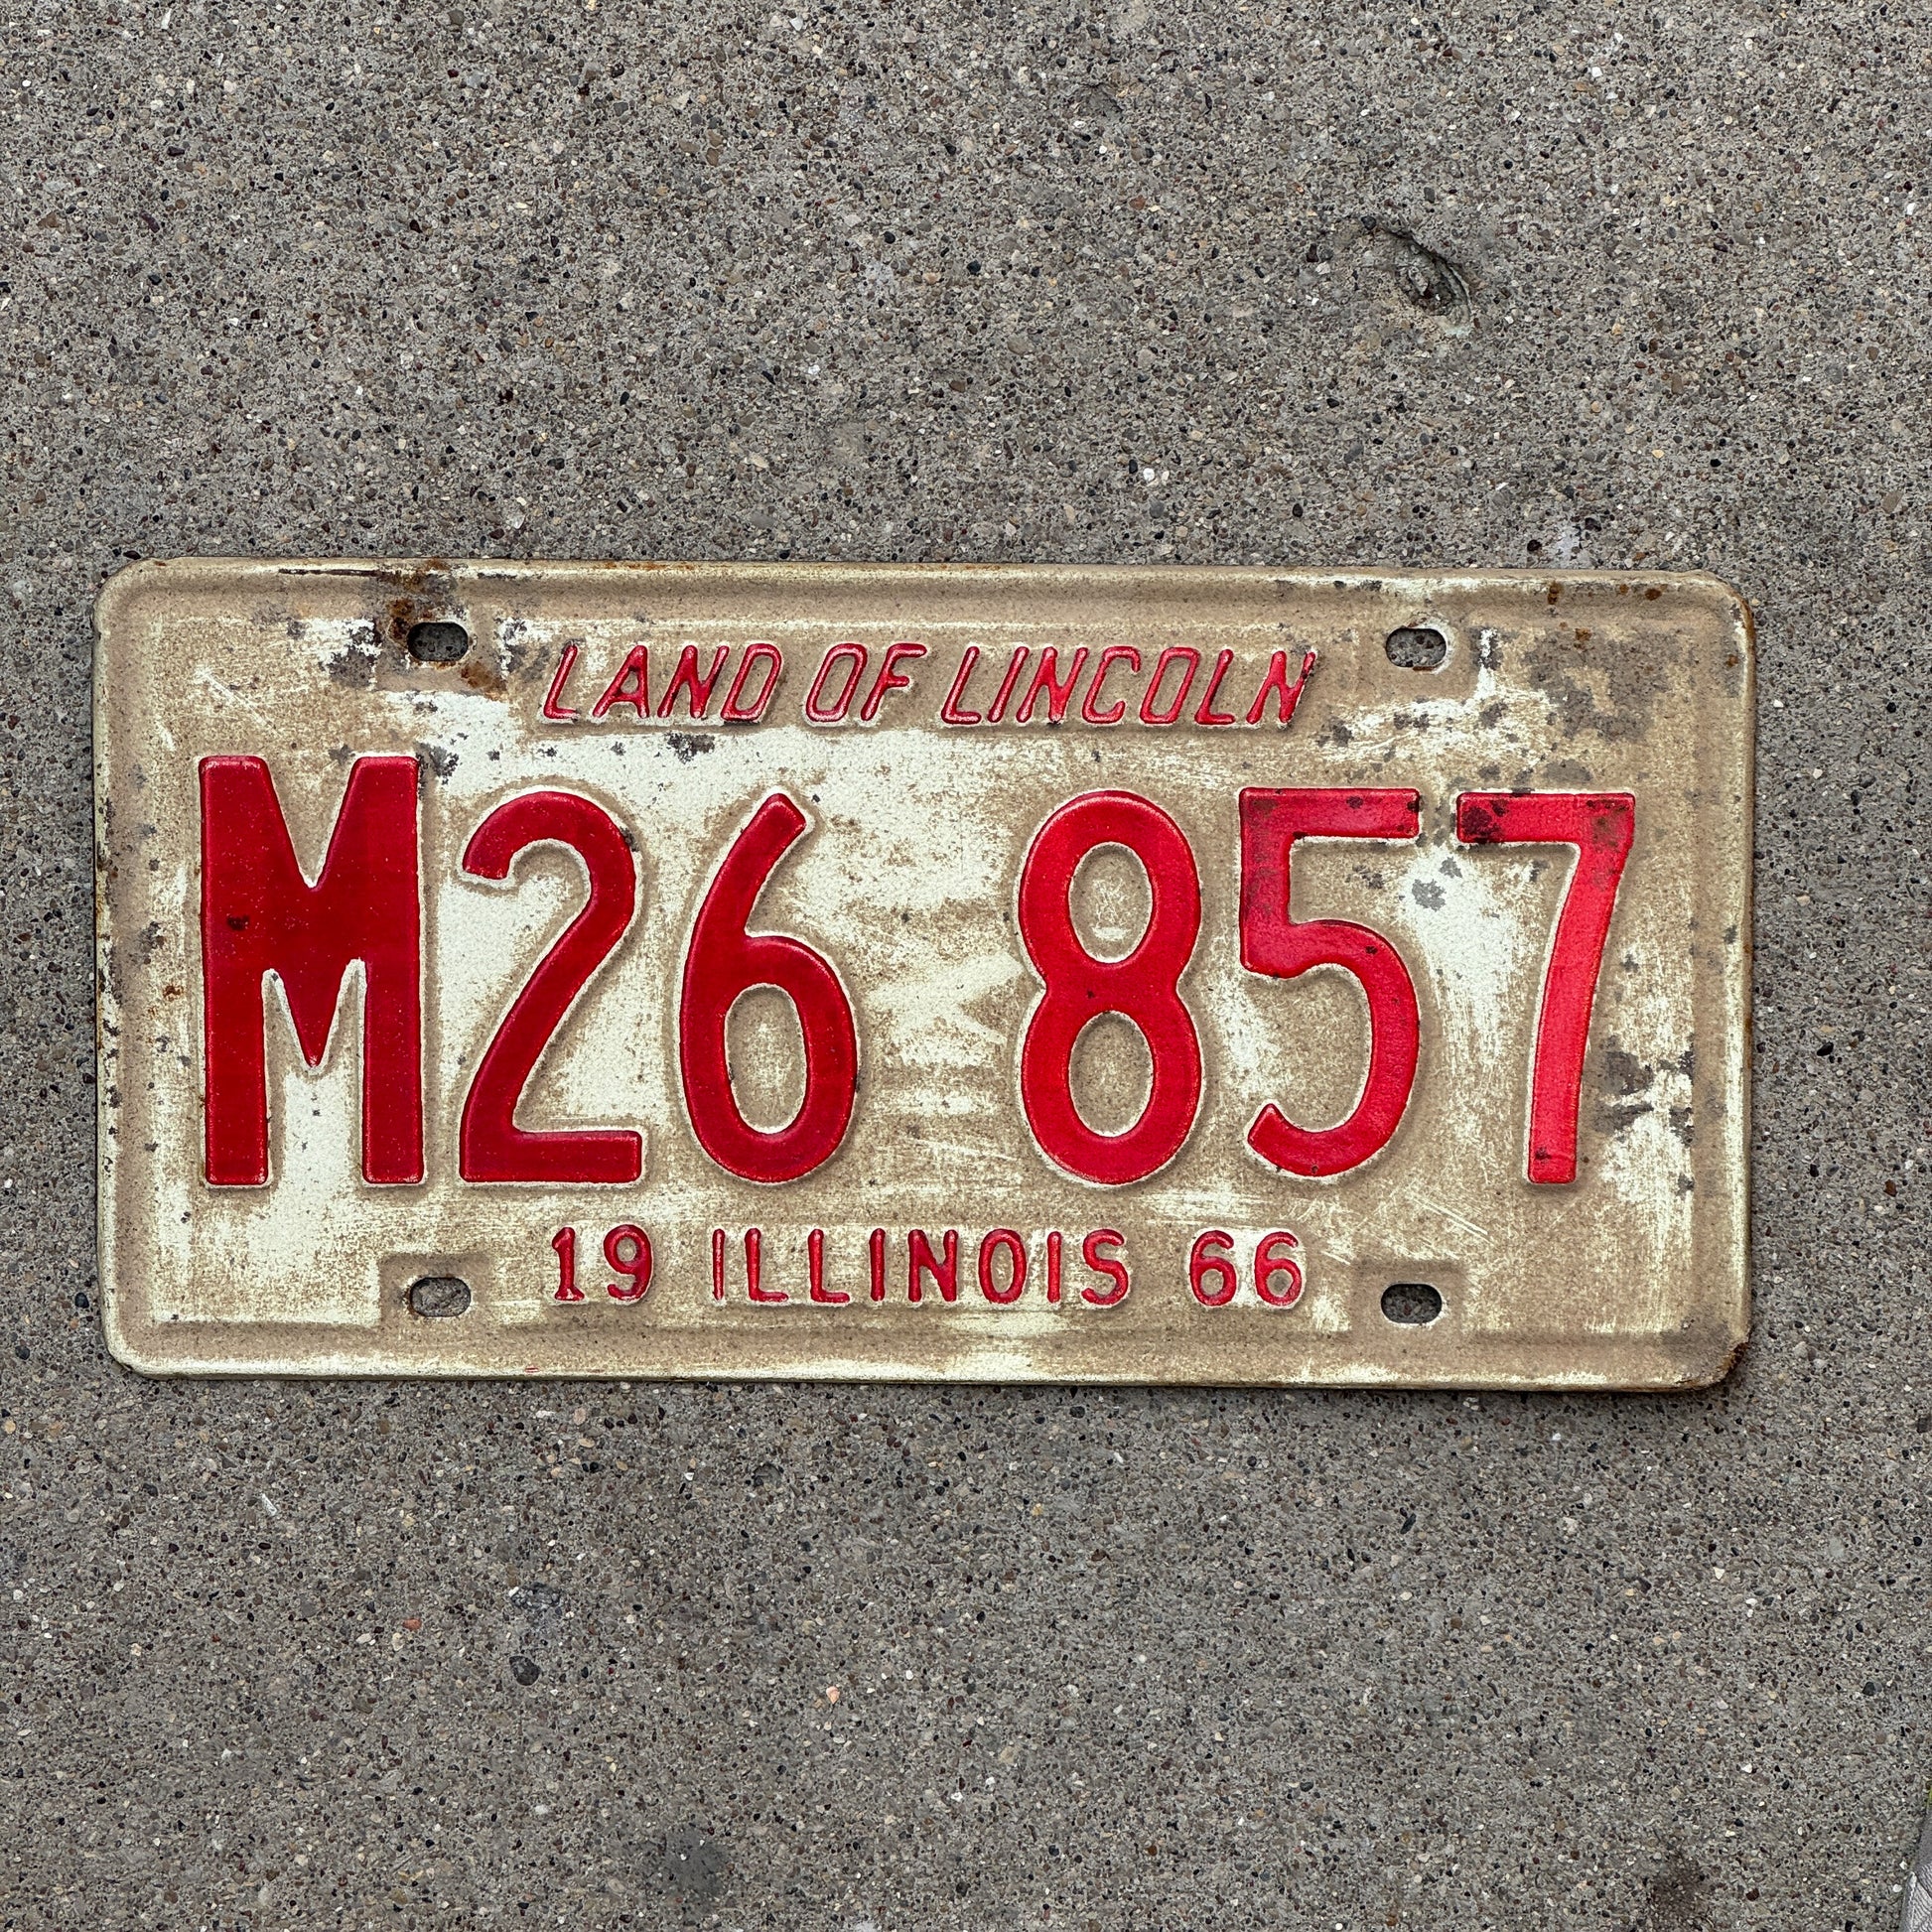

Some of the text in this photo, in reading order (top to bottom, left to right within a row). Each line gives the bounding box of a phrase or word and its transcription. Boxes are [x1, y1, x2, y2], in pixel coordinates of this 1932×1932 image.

[543, 642, 1316, 726] LAND OF LINCOLN
[199, 755, 1636, 1185] M26 857
[552, 1224, 1303, 1307] 19 ILLINOIS 66
